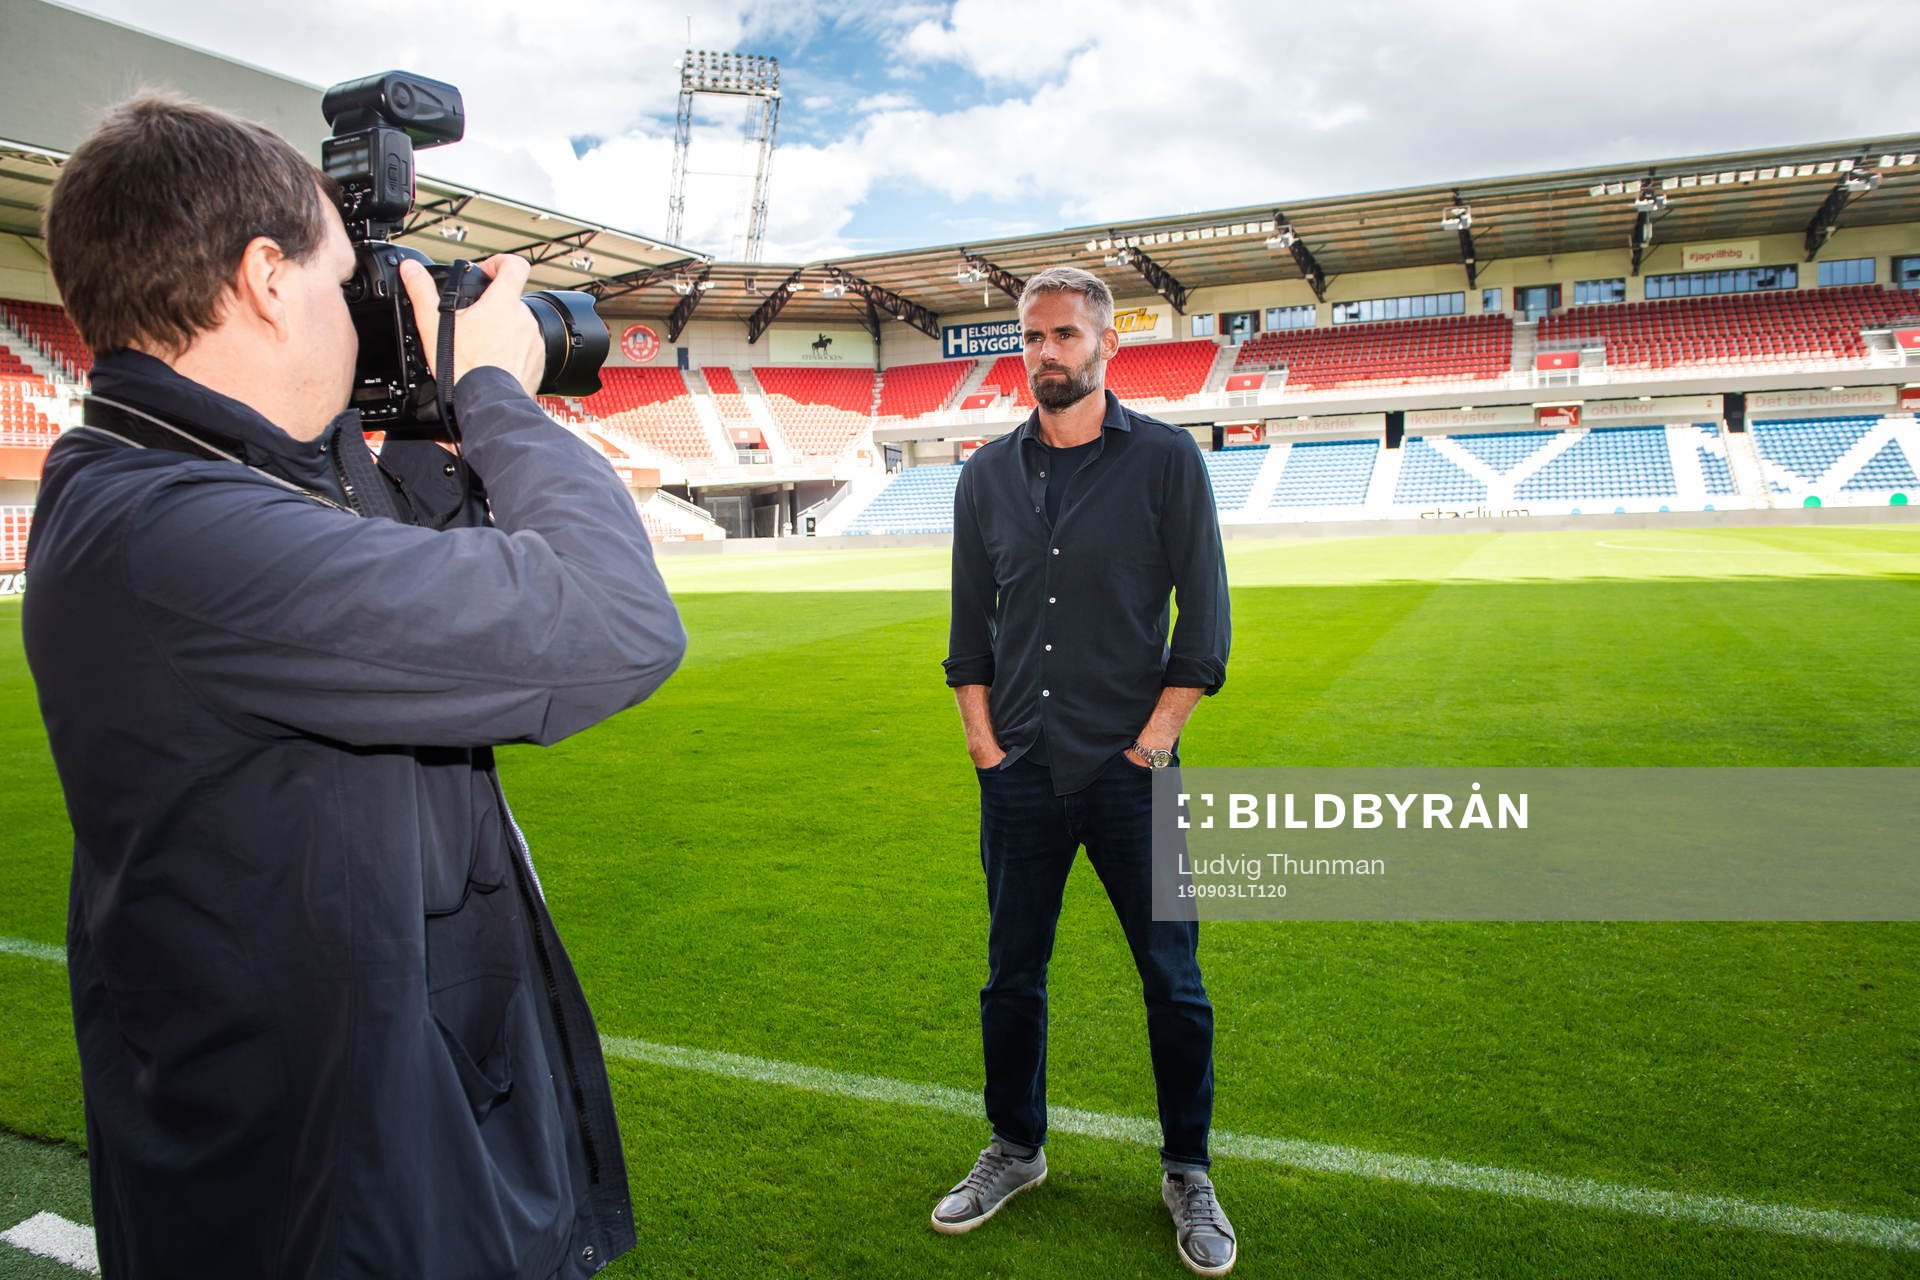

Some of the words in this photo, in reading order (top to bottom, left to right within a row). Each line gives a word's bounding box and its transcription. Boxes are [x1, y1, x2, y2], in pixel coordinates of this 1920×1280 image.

[1591, 402, 1618, 416] och
[1623, 401, 1656, 414] bror
[1754, 395, 1783, 408] Det
[1452, 410, 1498, 425] syster
